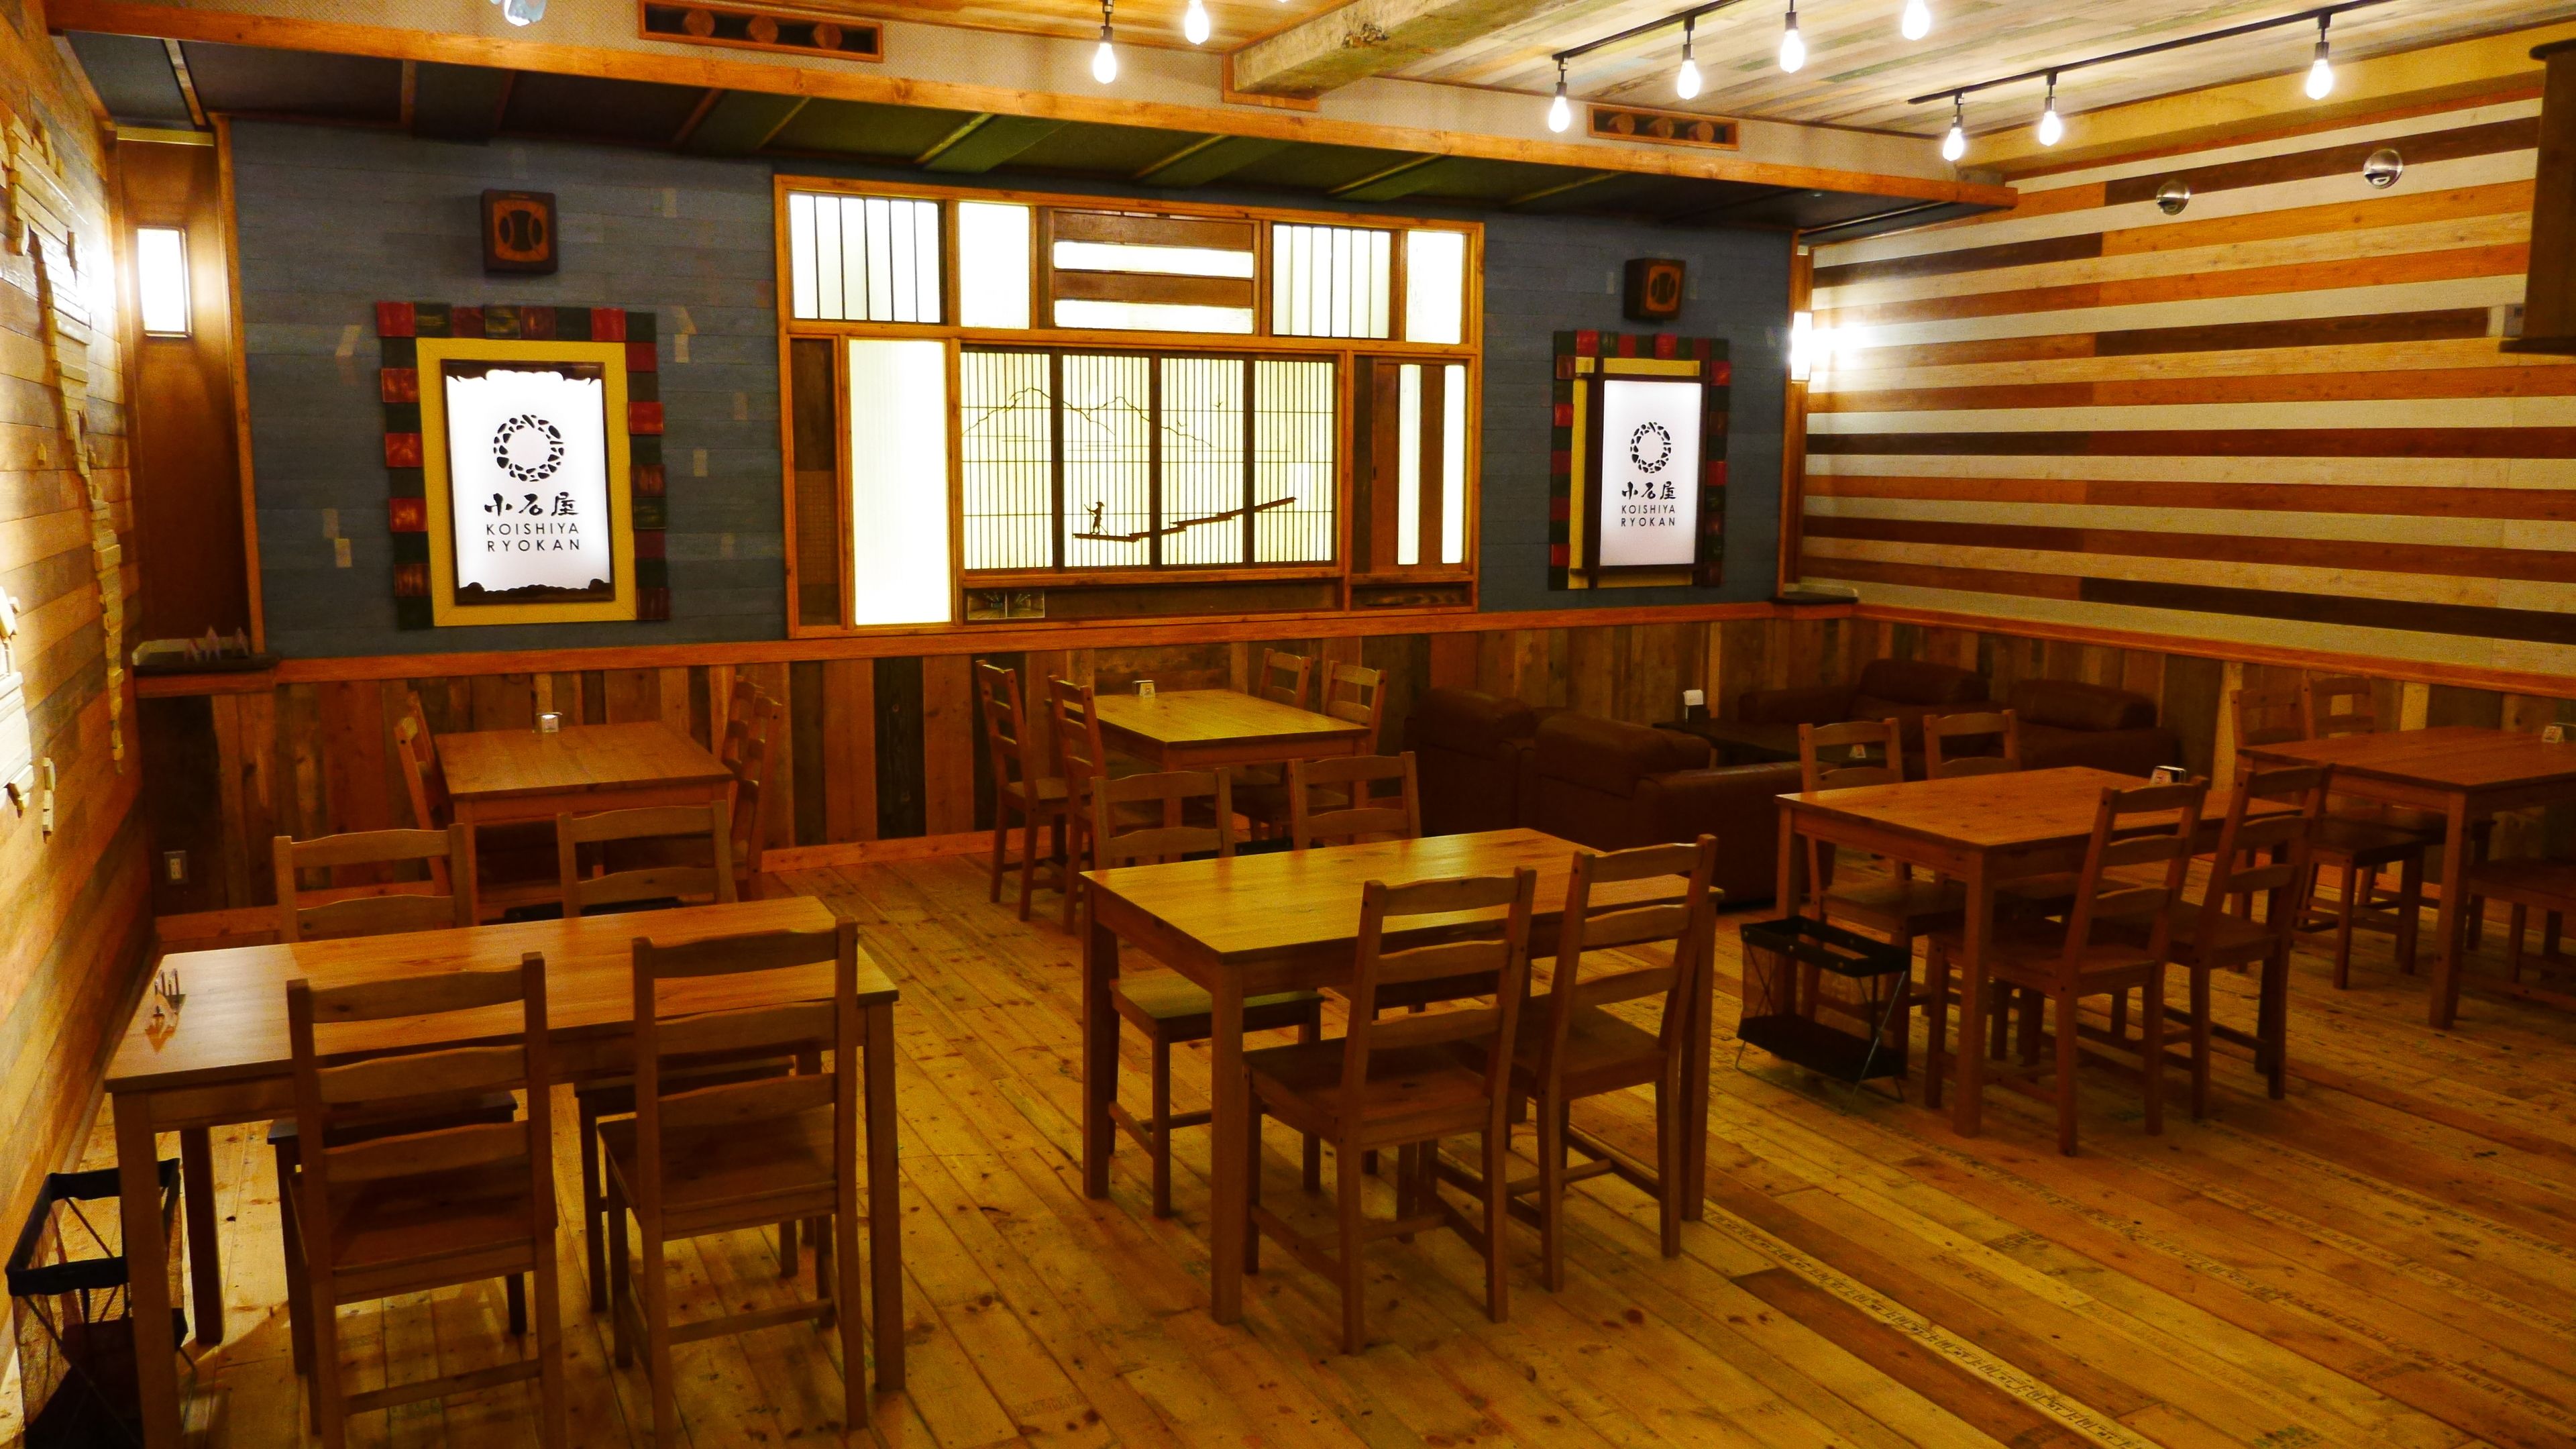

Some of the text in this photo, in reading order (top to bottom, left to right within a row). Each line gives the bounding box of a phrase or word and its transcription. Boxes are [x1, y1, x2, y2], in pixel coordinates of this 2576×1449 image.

[1621, 480, 1676, 500] 小石屋
[484, 491, 580, 517] 小石屋
[1621, 504, 1675, 515] KOISHIYA
[1621, 517, 1675, 527] RYOKAN
[486, 523, 579, 535] KOISHIYA
[488, 539, 580, 551] RYOKAN
